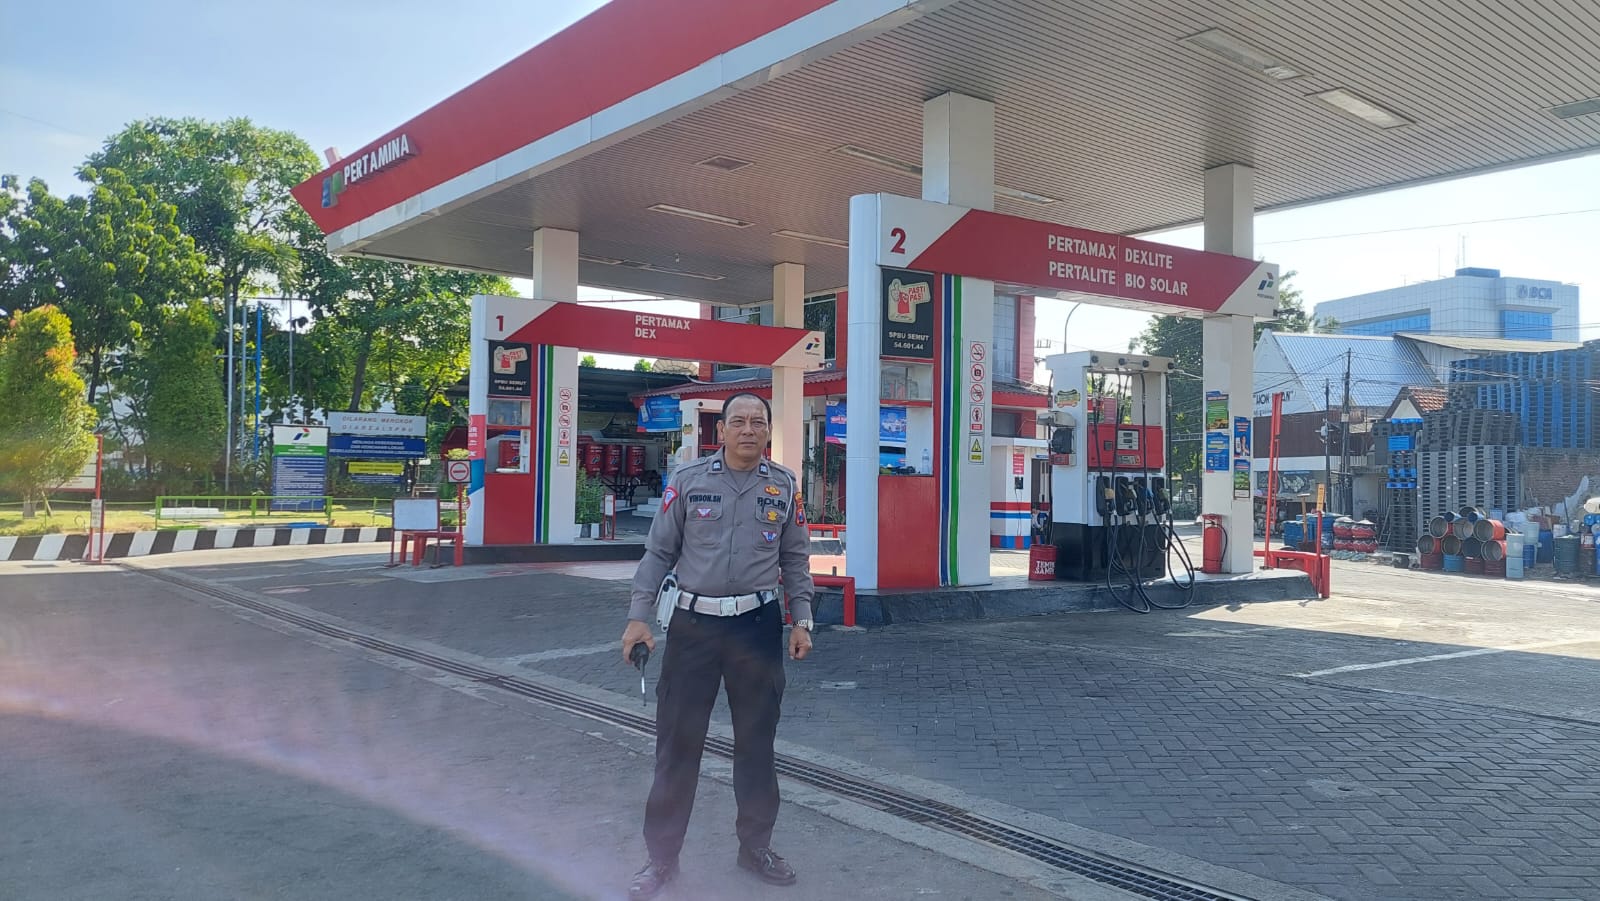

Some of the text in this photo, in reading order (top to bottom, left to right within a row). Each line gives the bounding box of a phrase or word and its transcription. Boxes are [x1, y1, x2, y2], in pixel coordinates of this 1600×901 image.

[344, 134, 409, 186] PERTAMINA
[890, 227, 907, 254] 2
[1048, 234, 1173, 269] PERTAMAX DEXLITE
[1049, 261, 1188, 296] PERTALITE BIO SOLAR
[908, 286, 926, 294] PASTI
[496, 315, 504, 331] 1
[635, 314, 691, 330] PERTAMAX
[635, 328, 656, 339] DEX
[888, 331, 930, 342] SPBU SEMUT
[757, 496, 787, 509] POLRI
